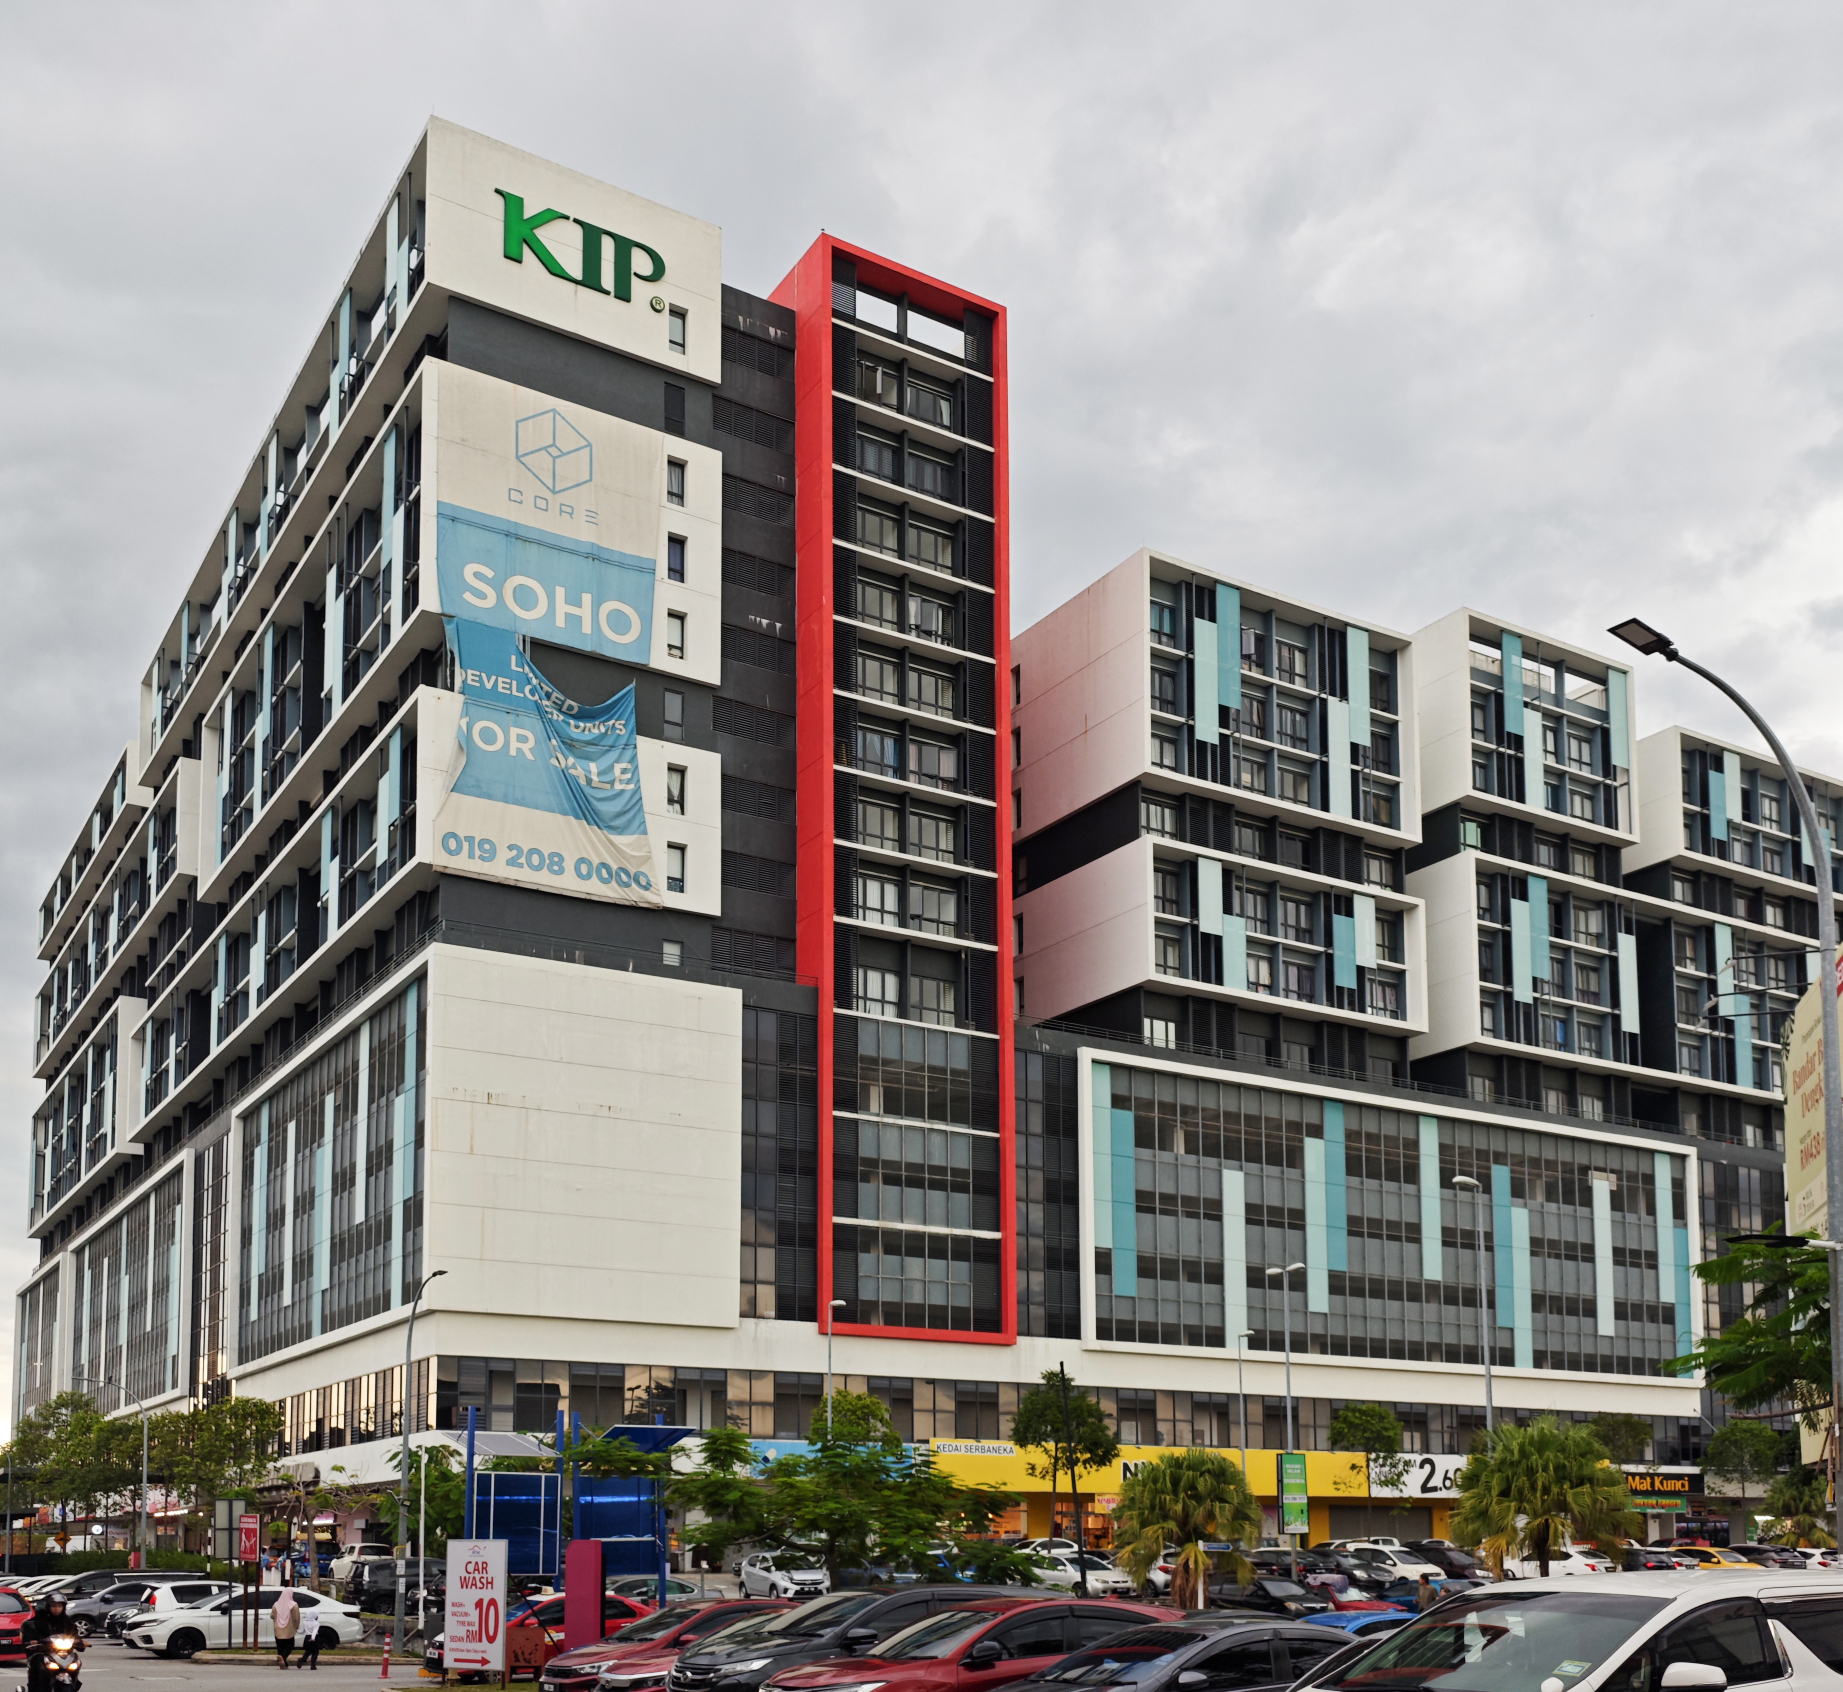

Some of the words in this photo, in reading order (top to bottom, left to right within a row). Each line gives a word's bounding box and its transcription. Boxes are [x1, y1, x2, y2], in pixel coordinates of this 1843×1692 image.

[494, 187, 666, 303] KIP
[508, 488, 599, 526] CORE
[462, 562, 642, 644] SOHO
[441, 831, 497, 863] 019
[506, 843, 565, 875] 208
[574, 857, 653, 891] 0000
[936, 1443, 962, 1453] KEDAI
[964, 1444, 1015, 1455] SERBANEKA
[1628, 1475, 1652, 1491] Mat
[1654, 1476, 1689, 1491] Kunci
[465, 1561, 488, 1575] CAR
[459, 1576, 494, 1590] WASH
